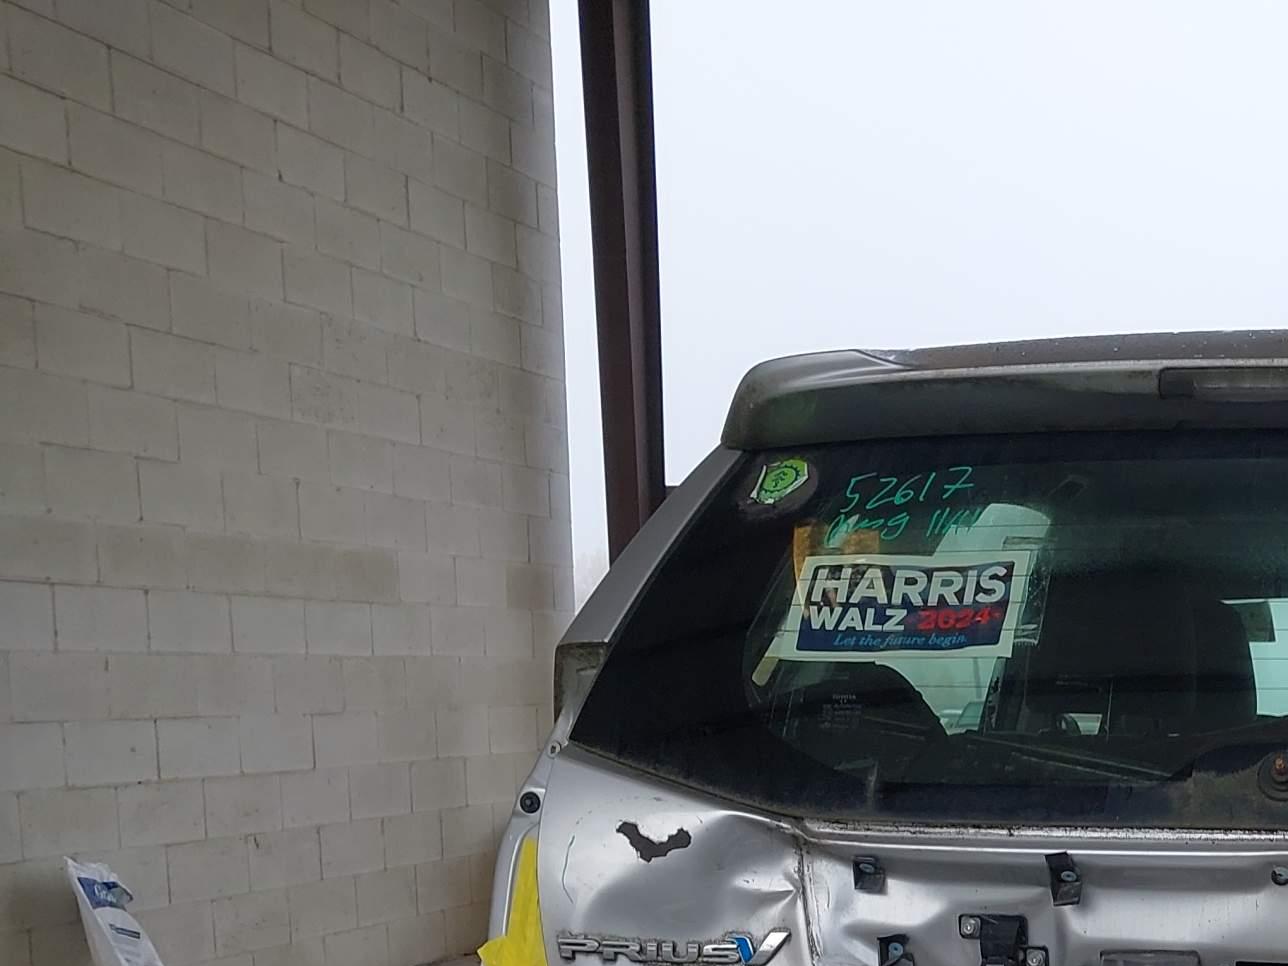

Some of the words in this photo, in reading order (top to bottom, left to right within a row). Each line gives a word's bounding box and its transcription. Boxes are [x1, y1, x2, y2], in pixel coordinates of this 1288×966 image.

[839, 466, 975, 512] 52617
[811, 566, 1008, 606] HARRIS
[809, 606, 908, 631] WALZ
[916, 606, 992, 631] 2024
[833, 632, 857, 646] Let
[860, 634, 880, 646] the
[880, 634, 925, 649] future
[557, 936, 740, 965] PRIUS
